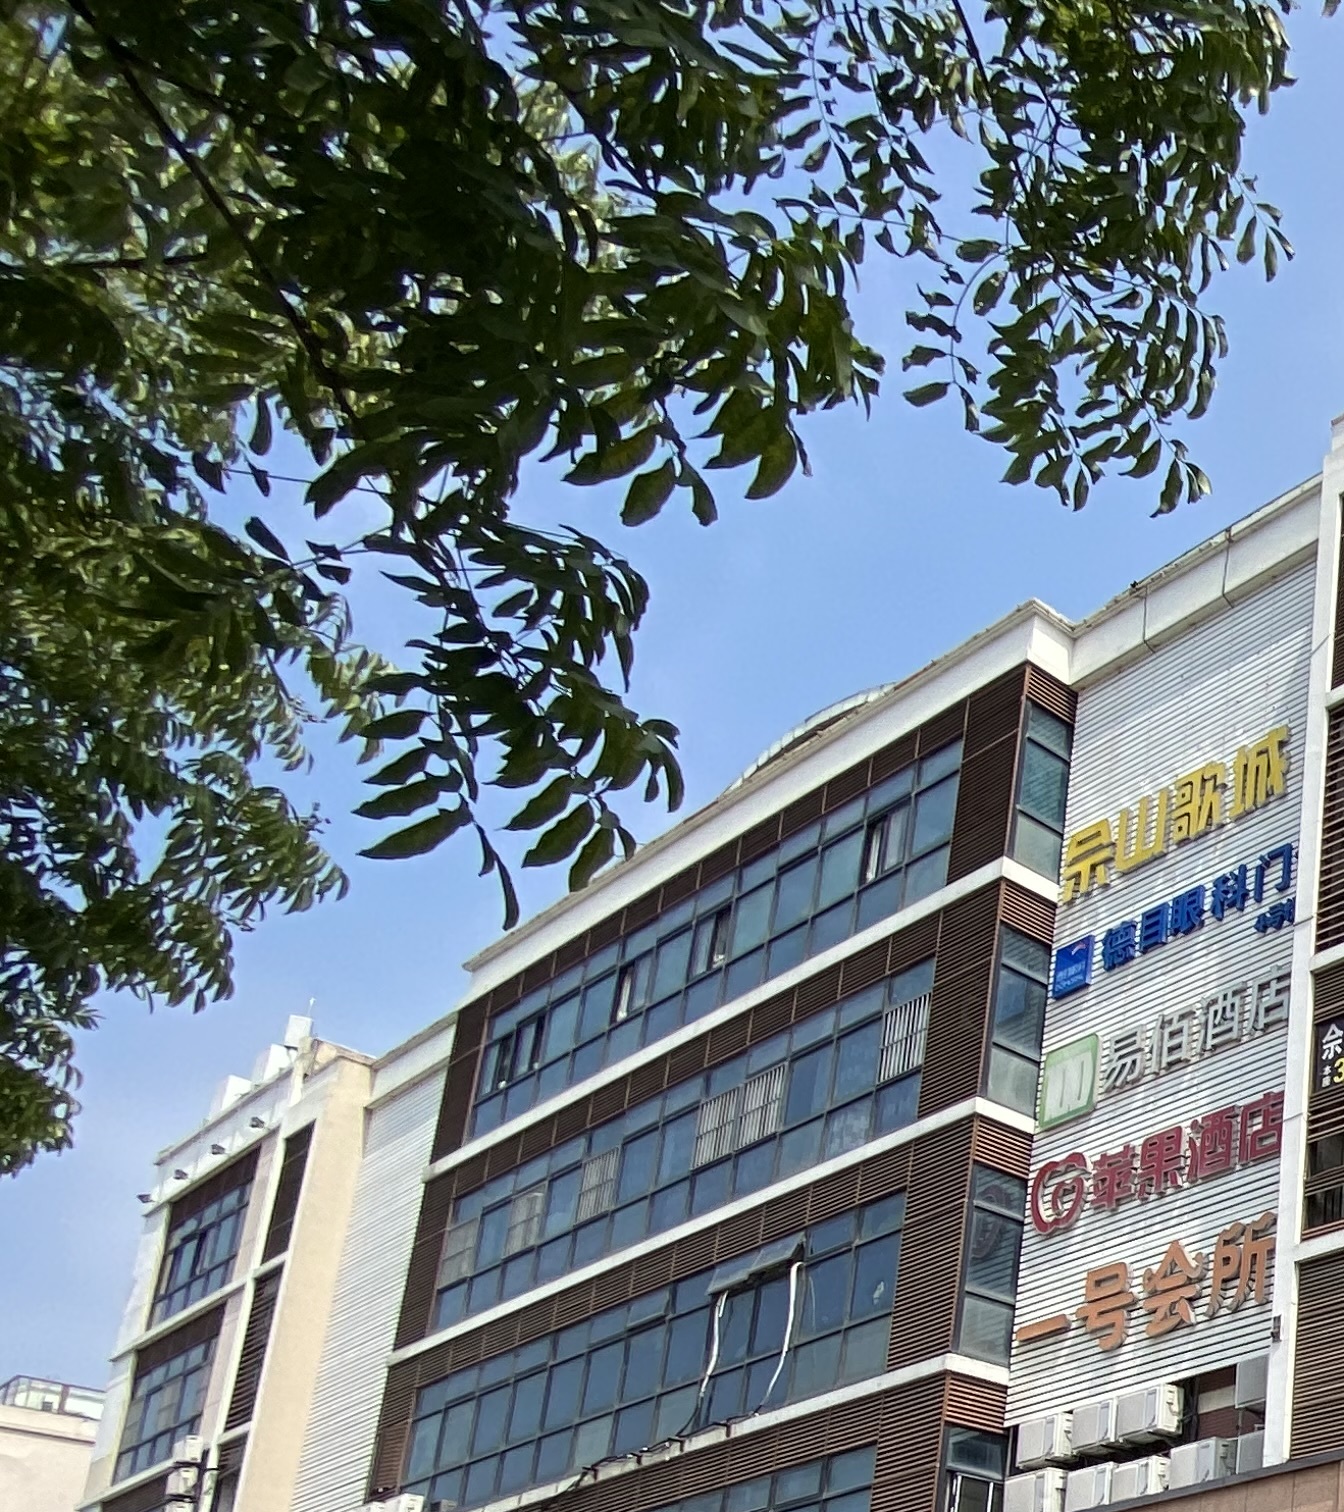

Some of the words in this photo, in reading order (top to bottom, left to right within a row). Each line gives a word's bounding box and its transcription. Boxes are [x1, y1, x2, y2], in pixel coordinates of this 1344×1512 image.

[1060, 723, 1292, 904] 佘山歌城
[1102, 964, 1293, 1090] 易佰酒店
[1091, 1091, 1285, 1211] 苹果酒店
[1016, 1211, 1278, 1349] 一号会所
